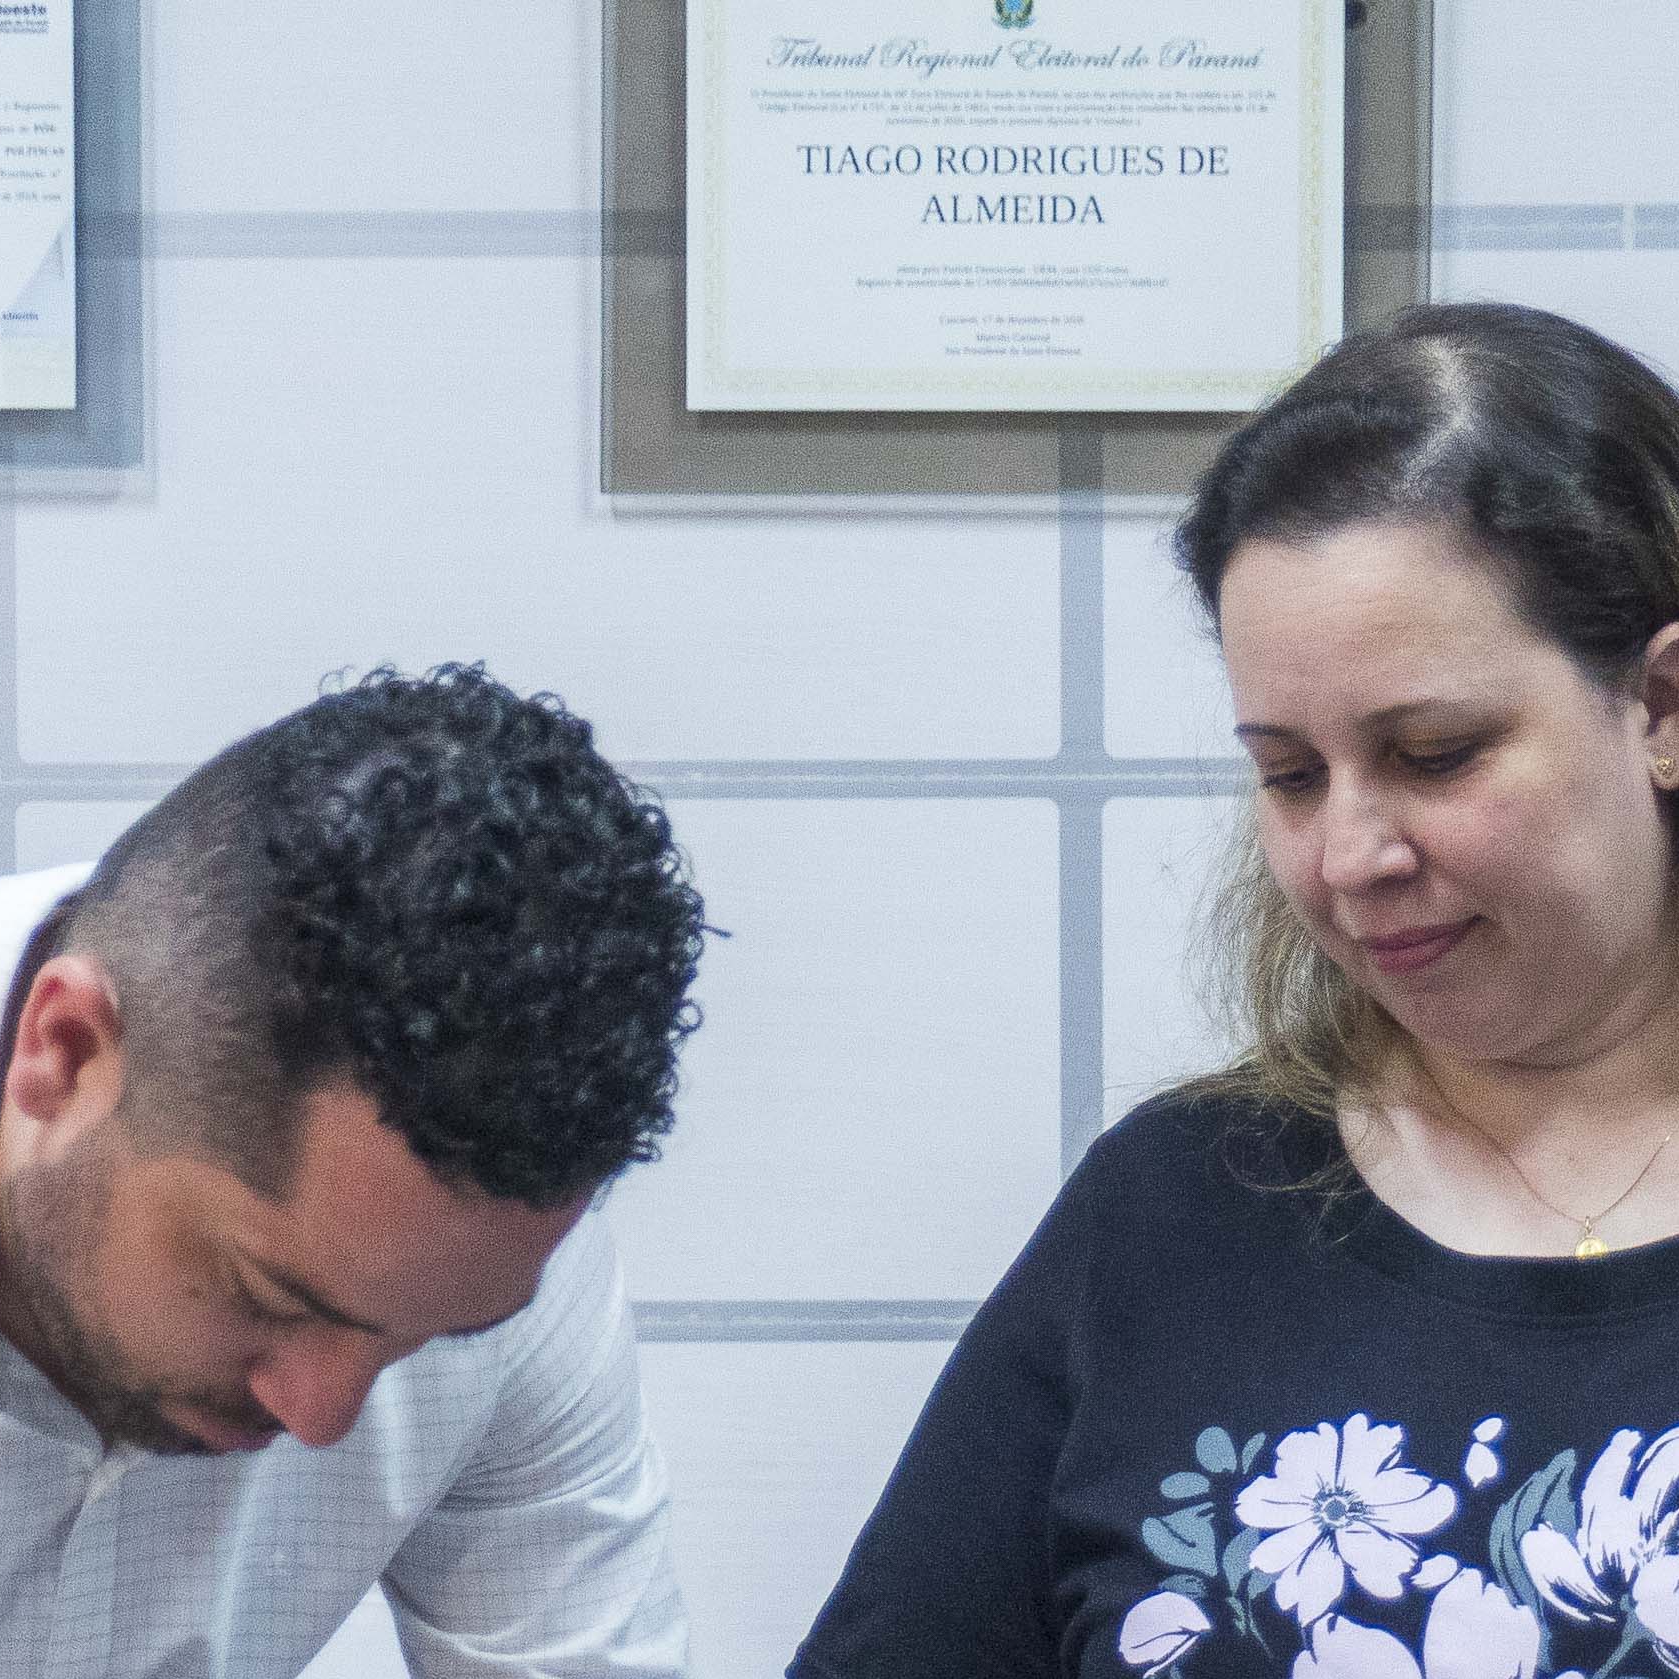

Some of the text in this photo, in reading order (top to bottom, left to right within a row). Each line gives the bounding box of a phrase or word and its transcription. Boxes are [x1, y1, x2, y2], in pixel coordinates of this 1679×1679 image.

[765, 36, 1266, 80] Tribunal Regional Eleitoral do Paraná
[796, 144, 1231, 178] TIAGO RODRIGUES DE
[920, 194, 1107, 226] ALMEIDA
